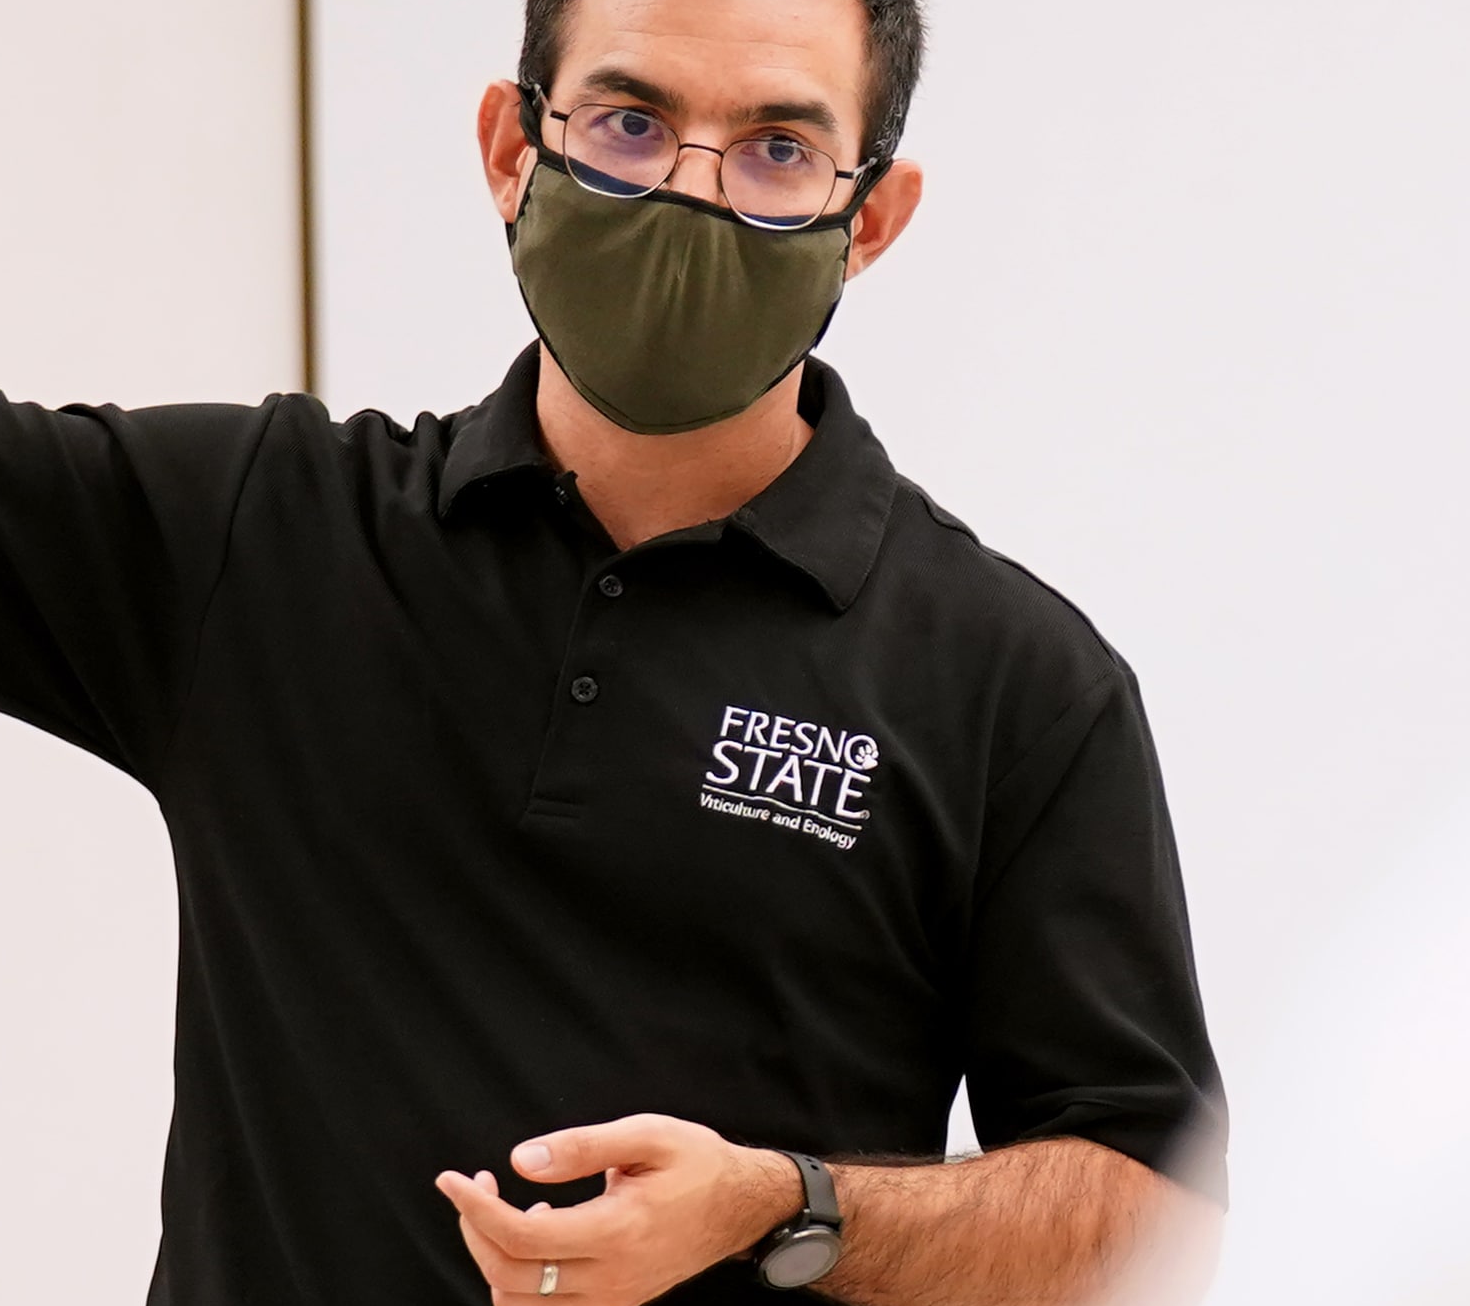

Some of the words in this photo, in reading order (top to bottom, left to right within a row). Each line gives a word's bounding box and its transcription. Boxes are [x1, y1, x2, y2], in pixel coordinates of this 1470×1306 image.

[719, 705, 879, 771] FRESNO
[705, 740, 871, 819] STATE
[699, 792, 771, 821] Viticulture
[772, 811, 801, 831] and
[802, 818, 857, 850] Enology
